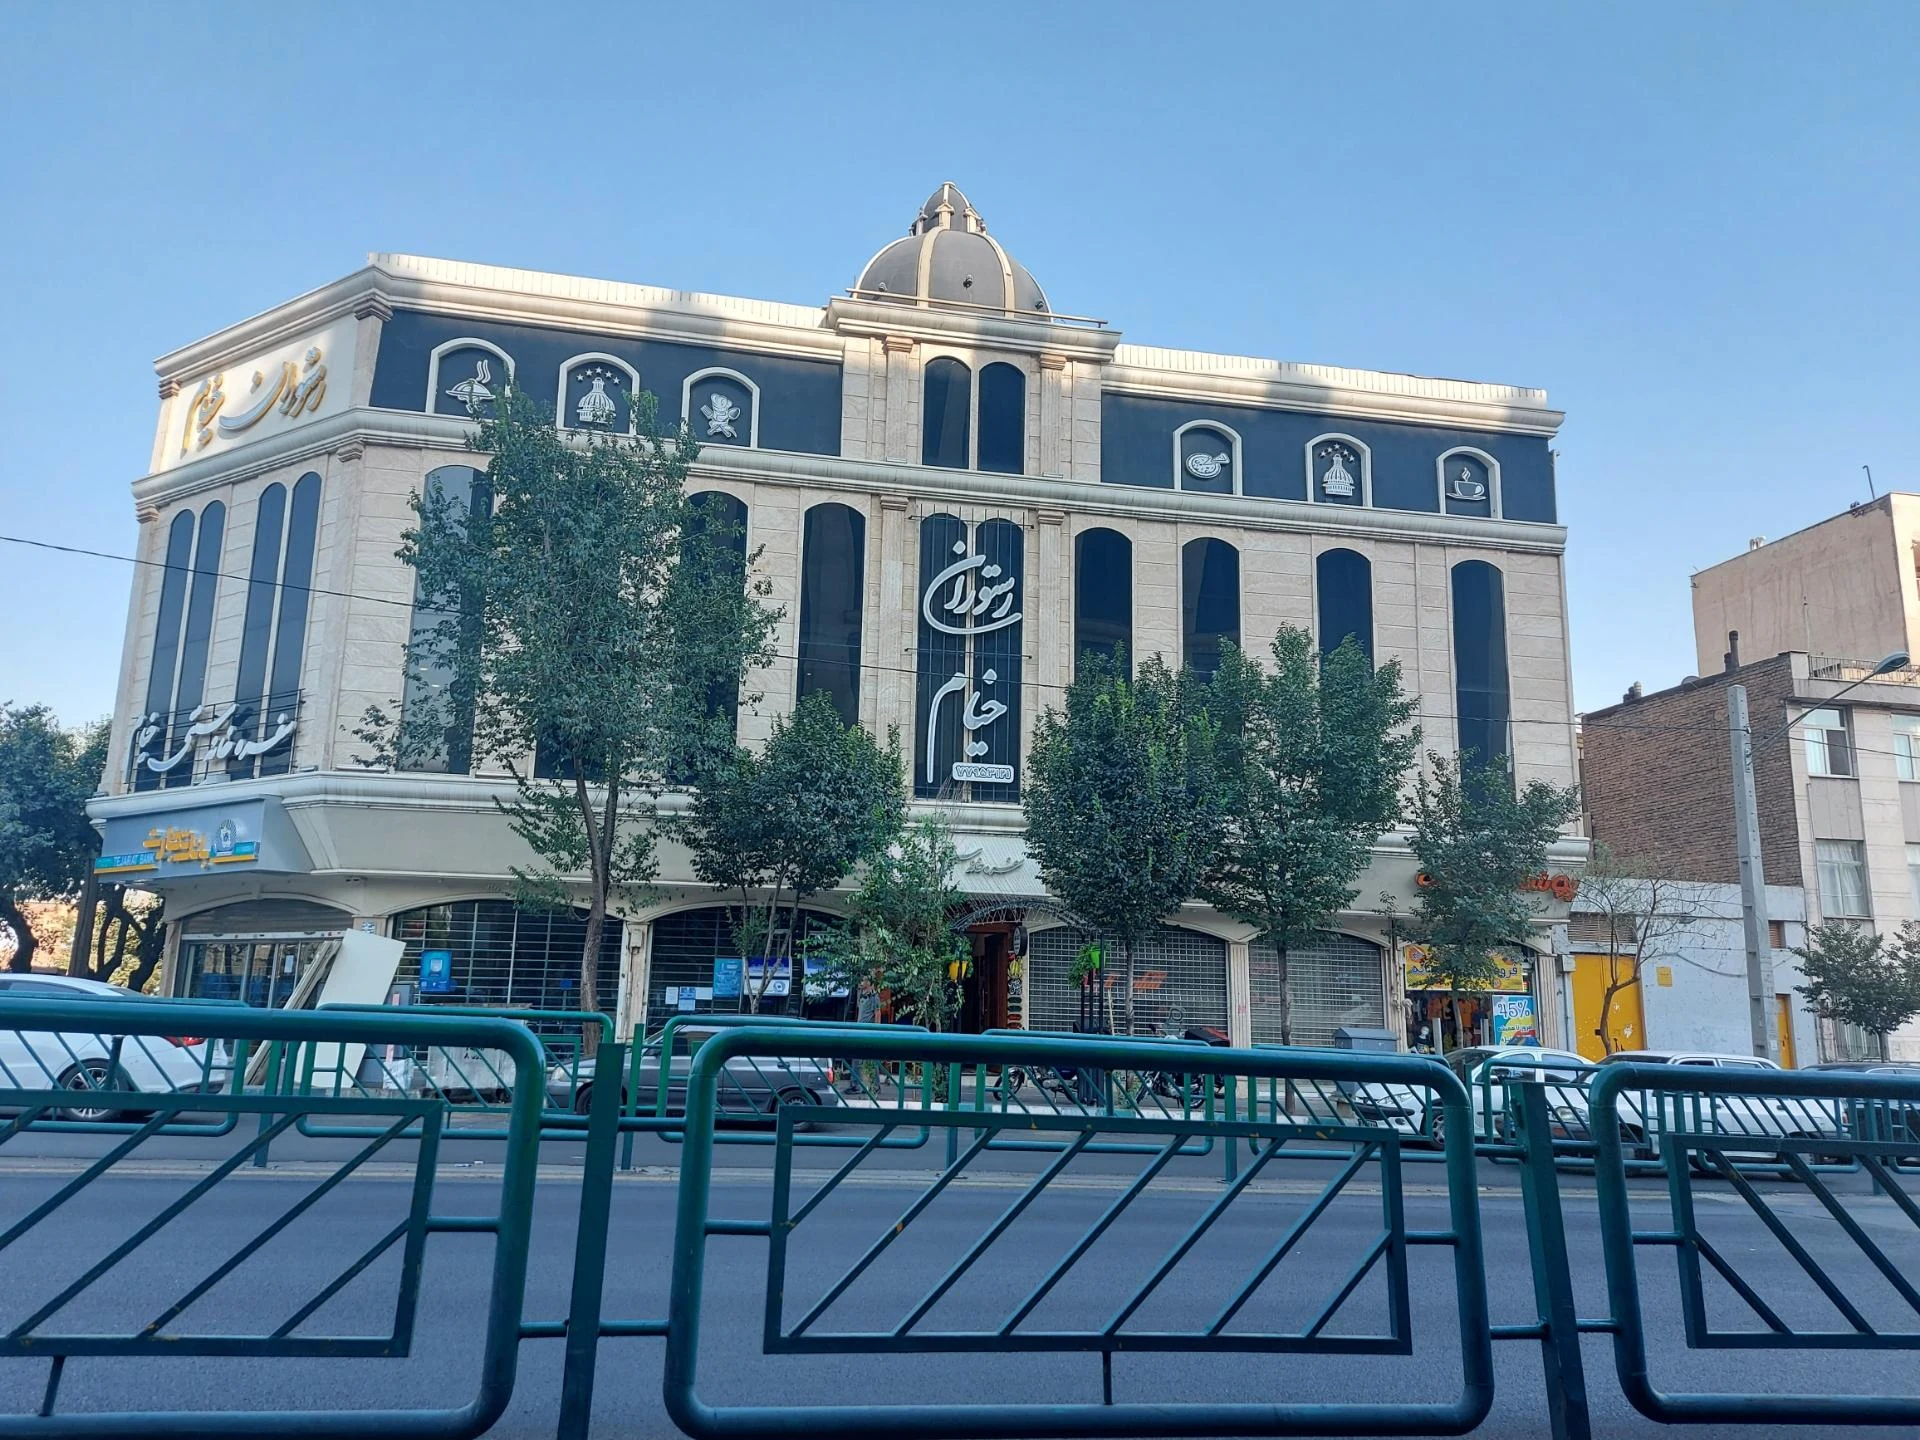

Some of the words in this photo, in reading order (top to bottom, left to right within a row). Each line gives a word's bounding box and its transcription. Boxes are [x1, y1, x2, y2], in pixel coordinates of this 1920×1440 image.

[181, 372, 225, 455] خیام
[219, 346, 328, 431] رستوران
[923, 540, 1023, 635] رستوران
[125, 711, 160, 788] خیام
[926, 668, 1008, 783] خیام
